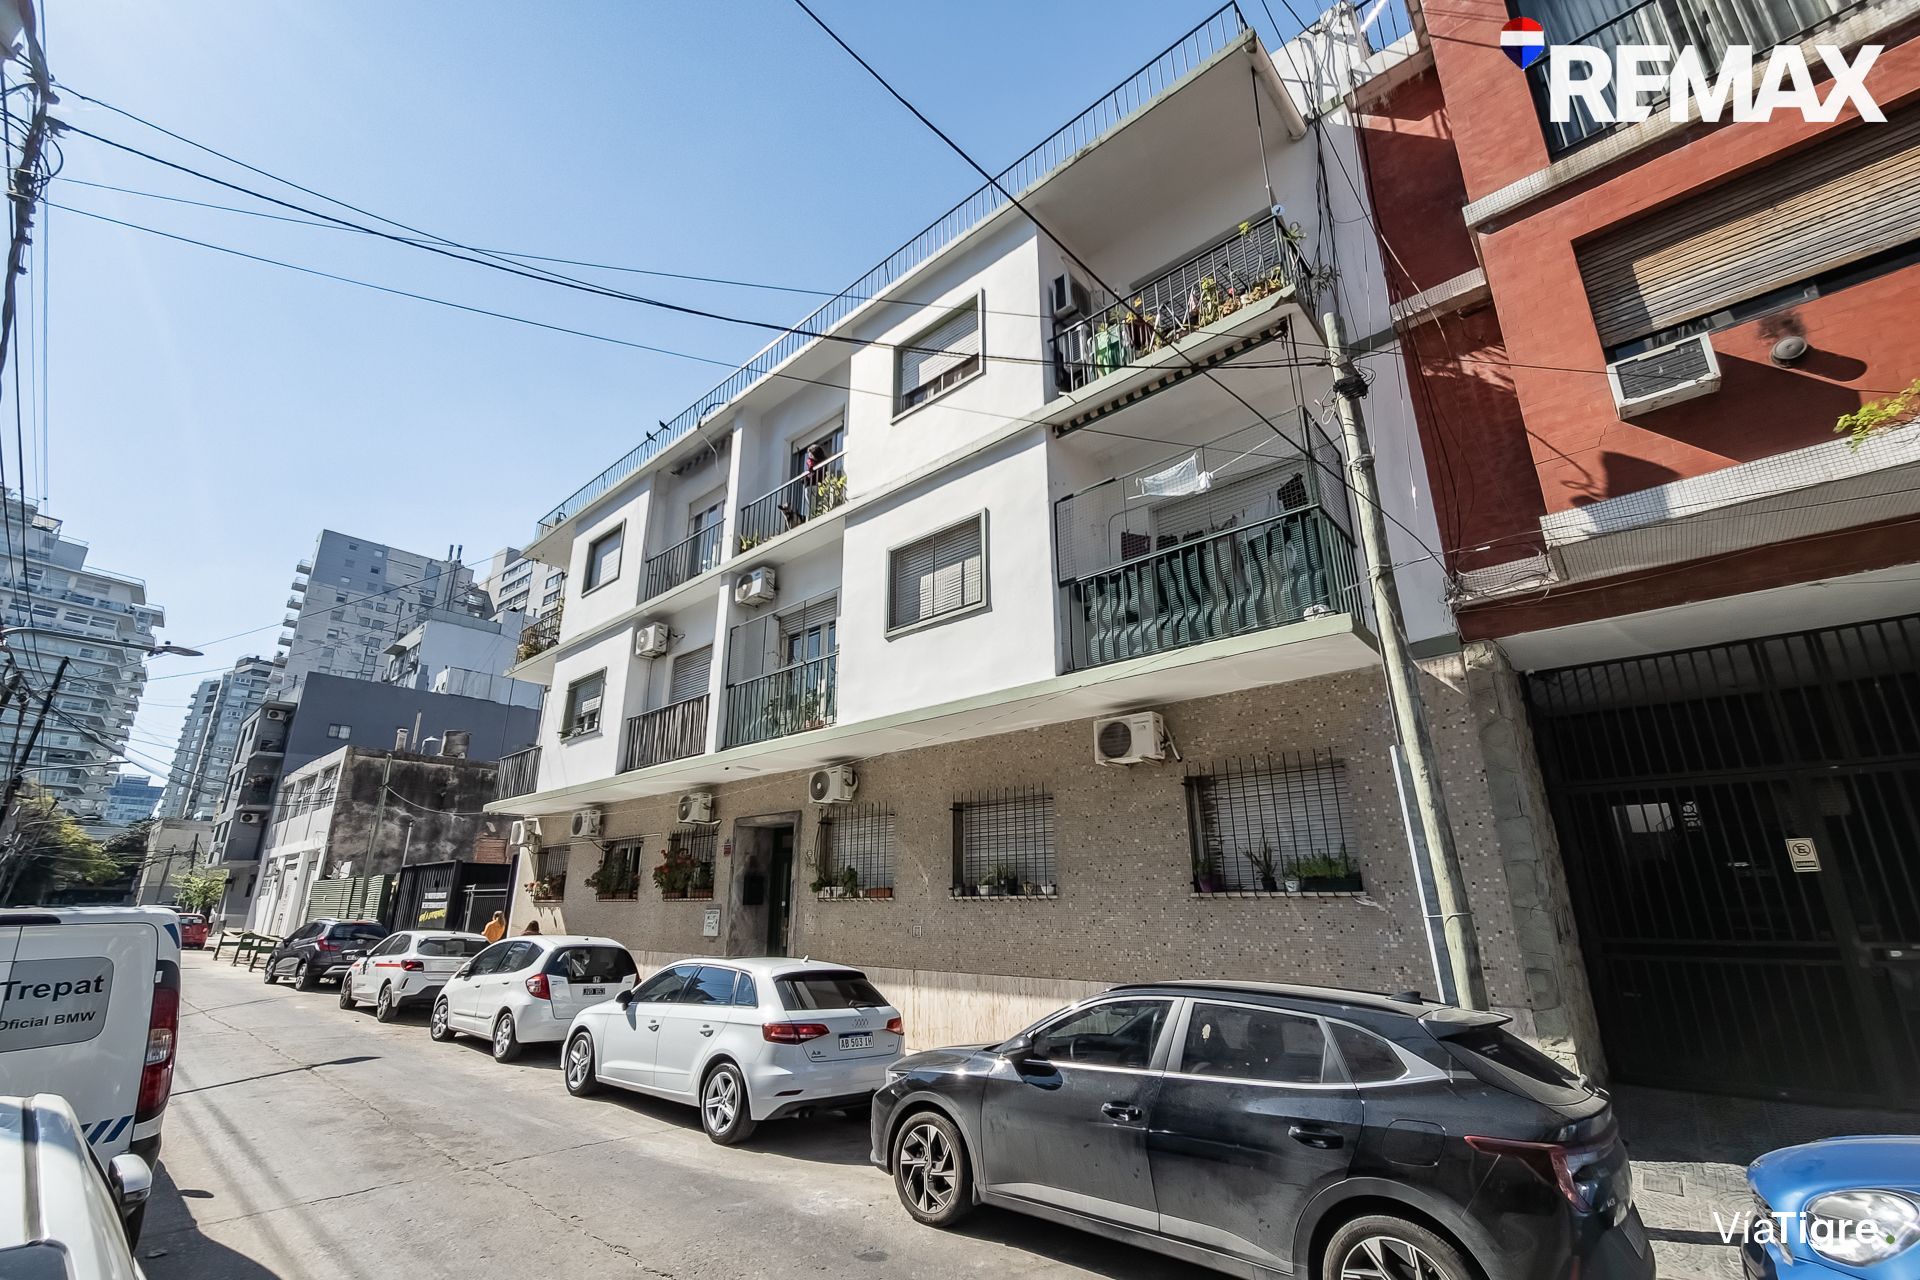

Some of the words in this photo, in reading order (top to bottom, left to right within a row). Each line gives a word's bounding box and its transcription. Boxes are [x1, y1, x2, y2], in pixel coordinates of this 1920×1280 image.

[0, 975, 104, 1002] Trepat
[0, 1016, 49, 1030] Oficial
[54, 1011, 96, 1025] BMW
